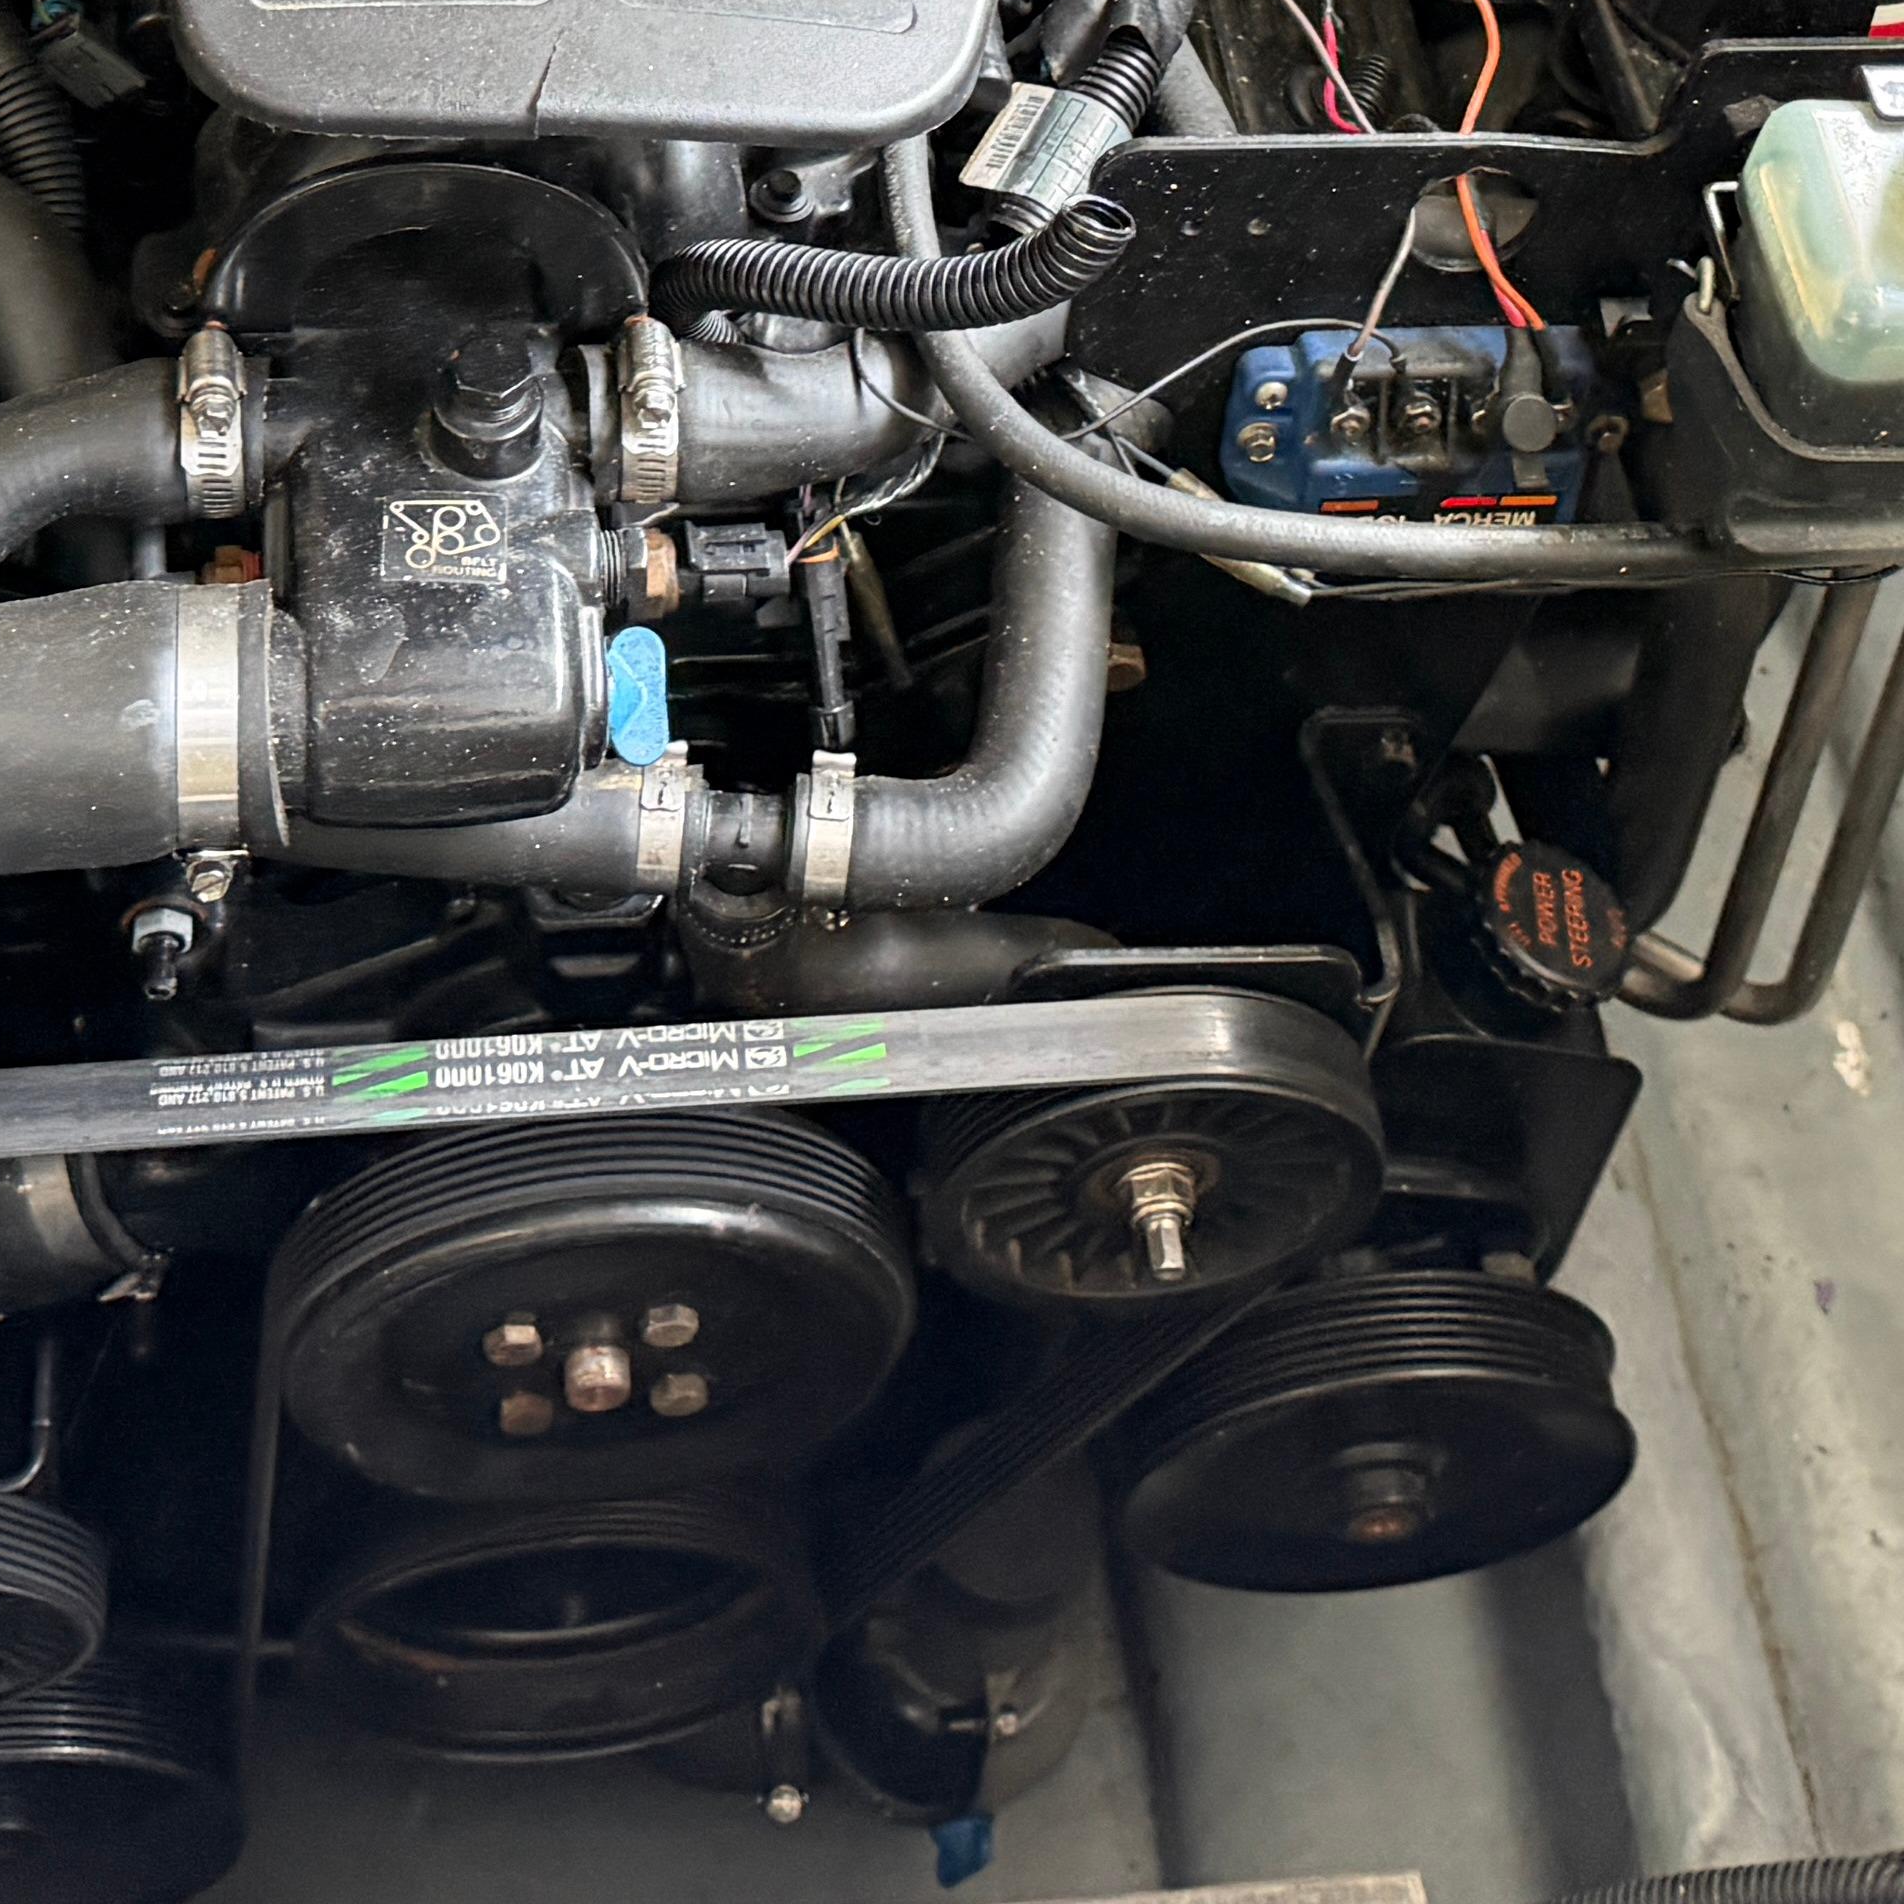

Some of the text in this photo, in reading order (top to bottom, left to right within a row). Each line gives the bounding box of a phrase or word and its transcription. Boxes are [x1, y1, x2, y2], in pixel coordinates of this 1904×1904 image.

[1532, 872, 1557, 947] POWER
[1561, 869, 1593, 967] STEERING
[434, 1060, 543, 1089] K061000
